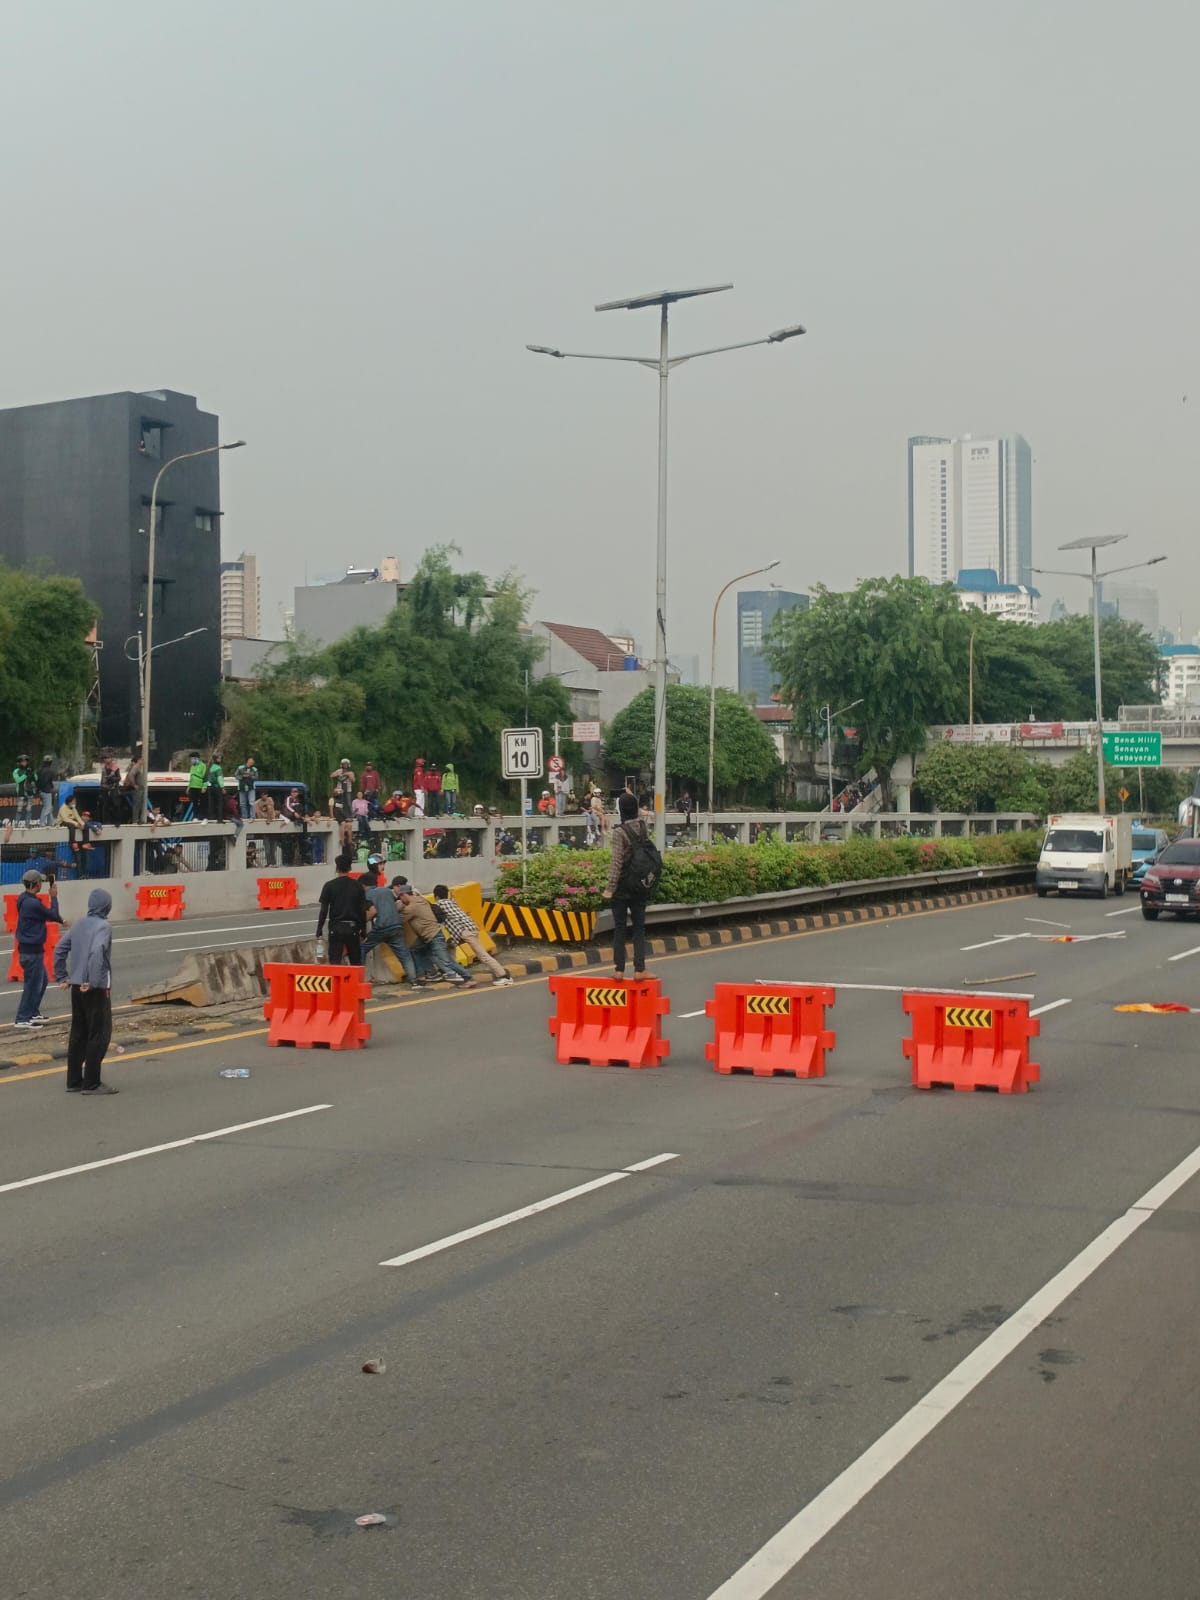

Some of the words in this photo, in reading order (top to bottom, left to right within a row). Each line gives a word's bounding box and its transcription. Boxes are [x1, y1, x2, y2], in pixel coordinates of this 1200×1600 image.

[514, 737, 527, 747] KM
[1137, 736, 1157, 744] Hilir
[1114, 745, 1149, 753] Senayan
[511, 751, 529, 768] 10
